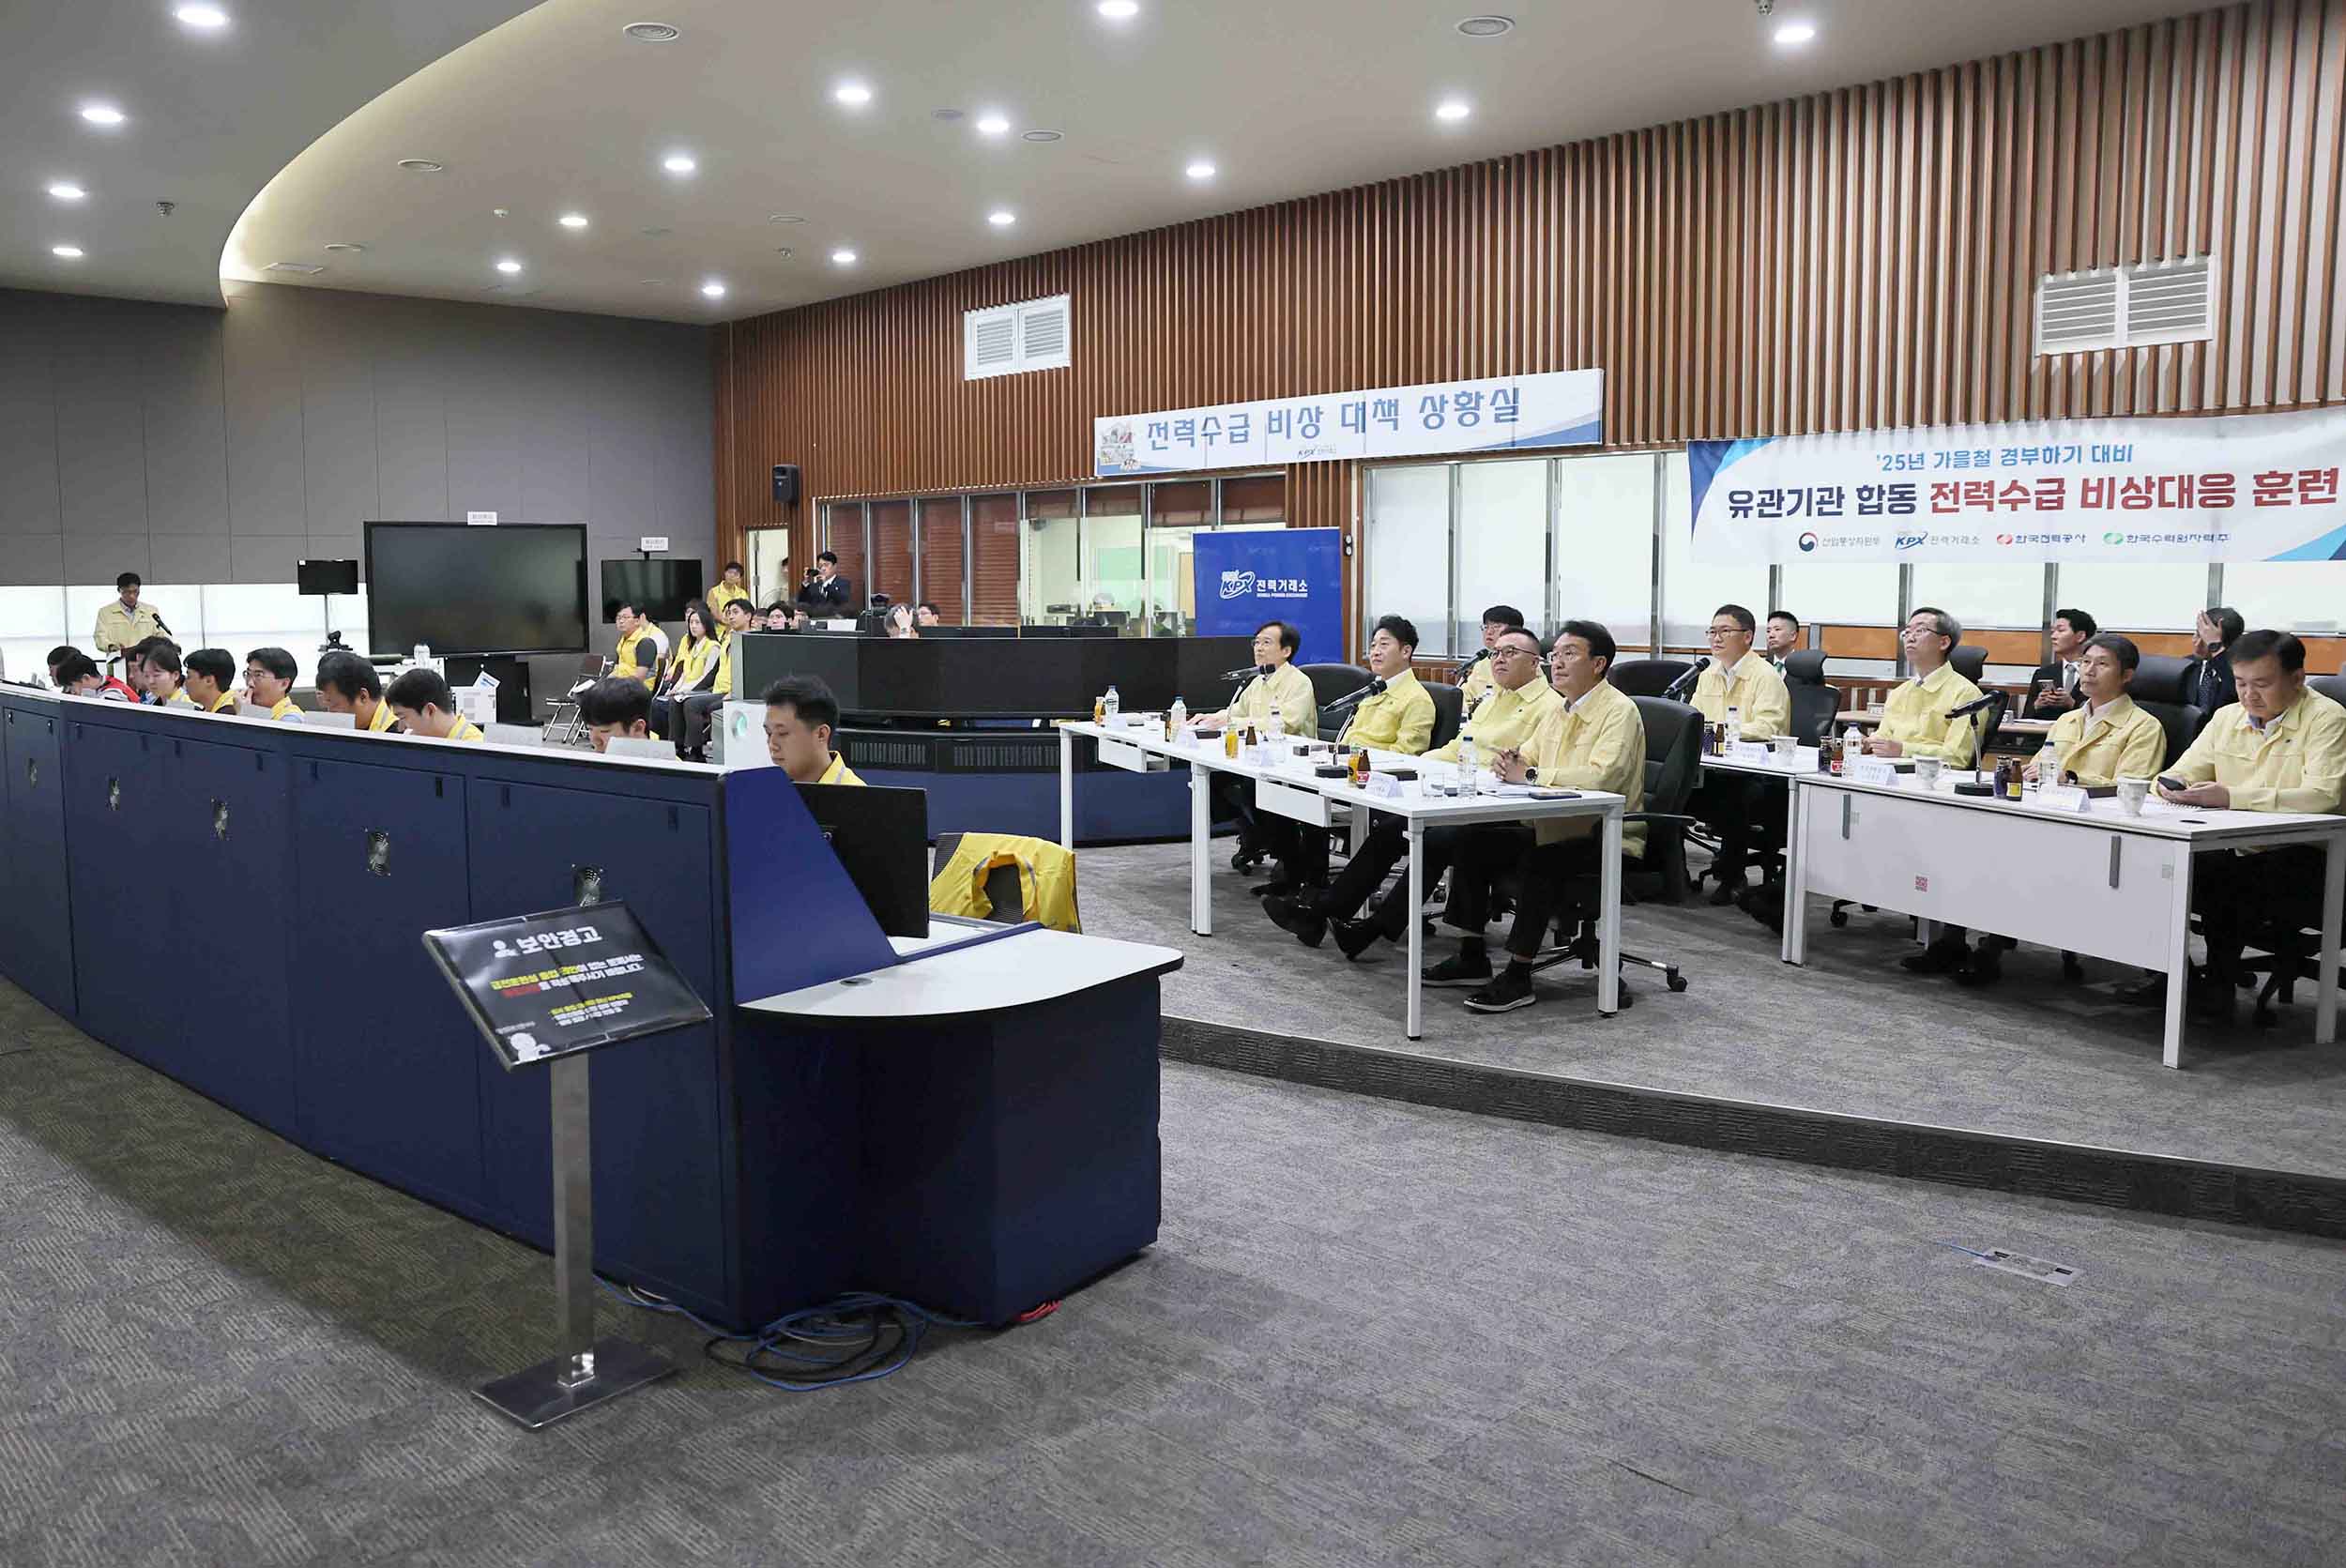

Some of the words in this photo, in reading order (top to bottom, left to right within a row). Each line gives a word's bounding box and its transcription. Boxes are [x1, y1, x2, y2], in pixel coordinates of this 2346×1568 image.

[1148, 413, 1250, 450] 전력수급
[1268, 405, 1324, 439] 비상
[1341, 398, 1398, 434] 대책
[1419, 387, 1519, 430] 상황실
[1933, 449, 1990, 468] 가을철
[2001, 445, 2082, 465] 경부하기
[2092, 444, 2133, 464] 대비
[1729, 486, 1845, 518] 유관기관
[1856, 482, 1917, 515] 합동
[1930, 478, 2065, 513] 전력수급
[2080, 473, 2236, 510] 비상대응
[2252, 467, 2339, 507] 훈련
[1895, 533, 1927, 549] KPX
[1220, 577, 1253, 598] KPX
[516, 926, 602, 954] 보안경고
